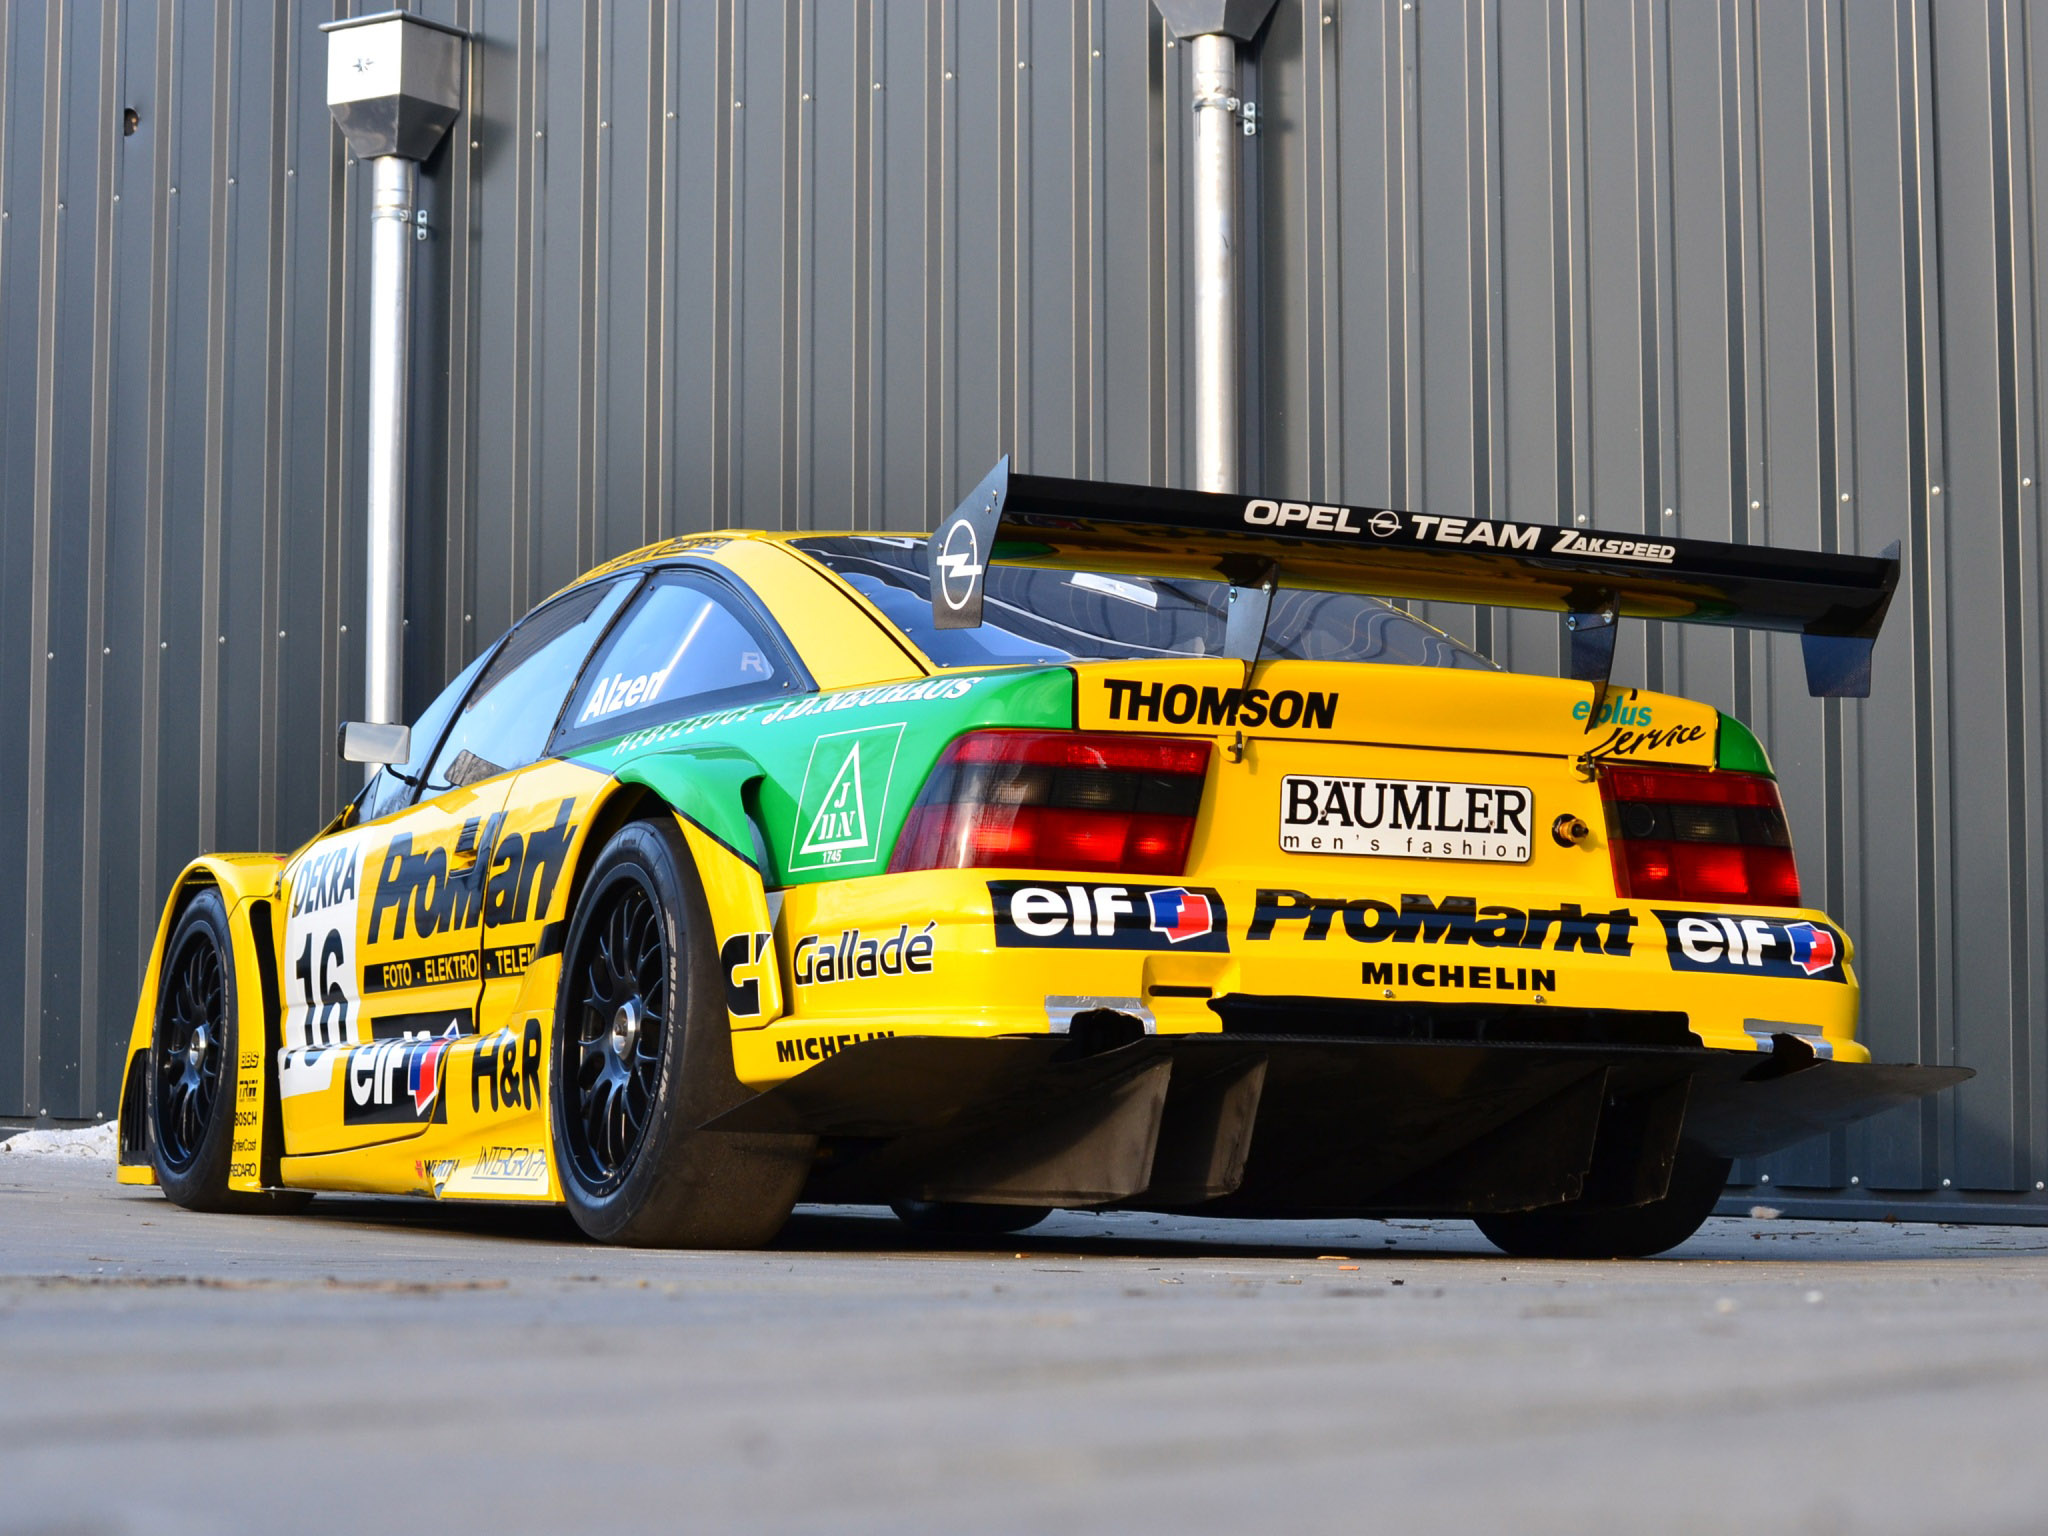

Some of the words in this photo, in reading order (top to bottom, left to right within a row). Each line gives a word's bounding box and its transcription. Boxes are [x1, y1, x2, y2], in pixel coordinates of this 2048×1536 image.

[1243, 499, 1361, 534] OPEL
[1411, 515, 1541, 550] TEAM
[1551, 530, 1676, 564] ZAKSPEED
[581, 669, 668, 722] Alzen
[1104, 678, 1339, 729] THOMSON
[1285, 778, 1527, 836] BÄUMLER
[822, 850, 842, 864] 1745
[1283, 834, 1380, 852] men's
[1406, 837, 1527, 859] fashion
[292, 843, 359, 918] DEKRA
[793, 920, 937, 986] Galladé
[1010, 886, 1133, 936] elf
[1246, 888, 1638, 956] ProMarkt
[1677, 917, 1776, 967] elf
[284, 928, 348, 1069] 16
[383, 962, 412, 988] FOTO
[424, 952, 478, 983] ELEKTRO
[1361, 961, 1556, 992] MICHELIN
[471, 1018, 542, 1114] H&R
